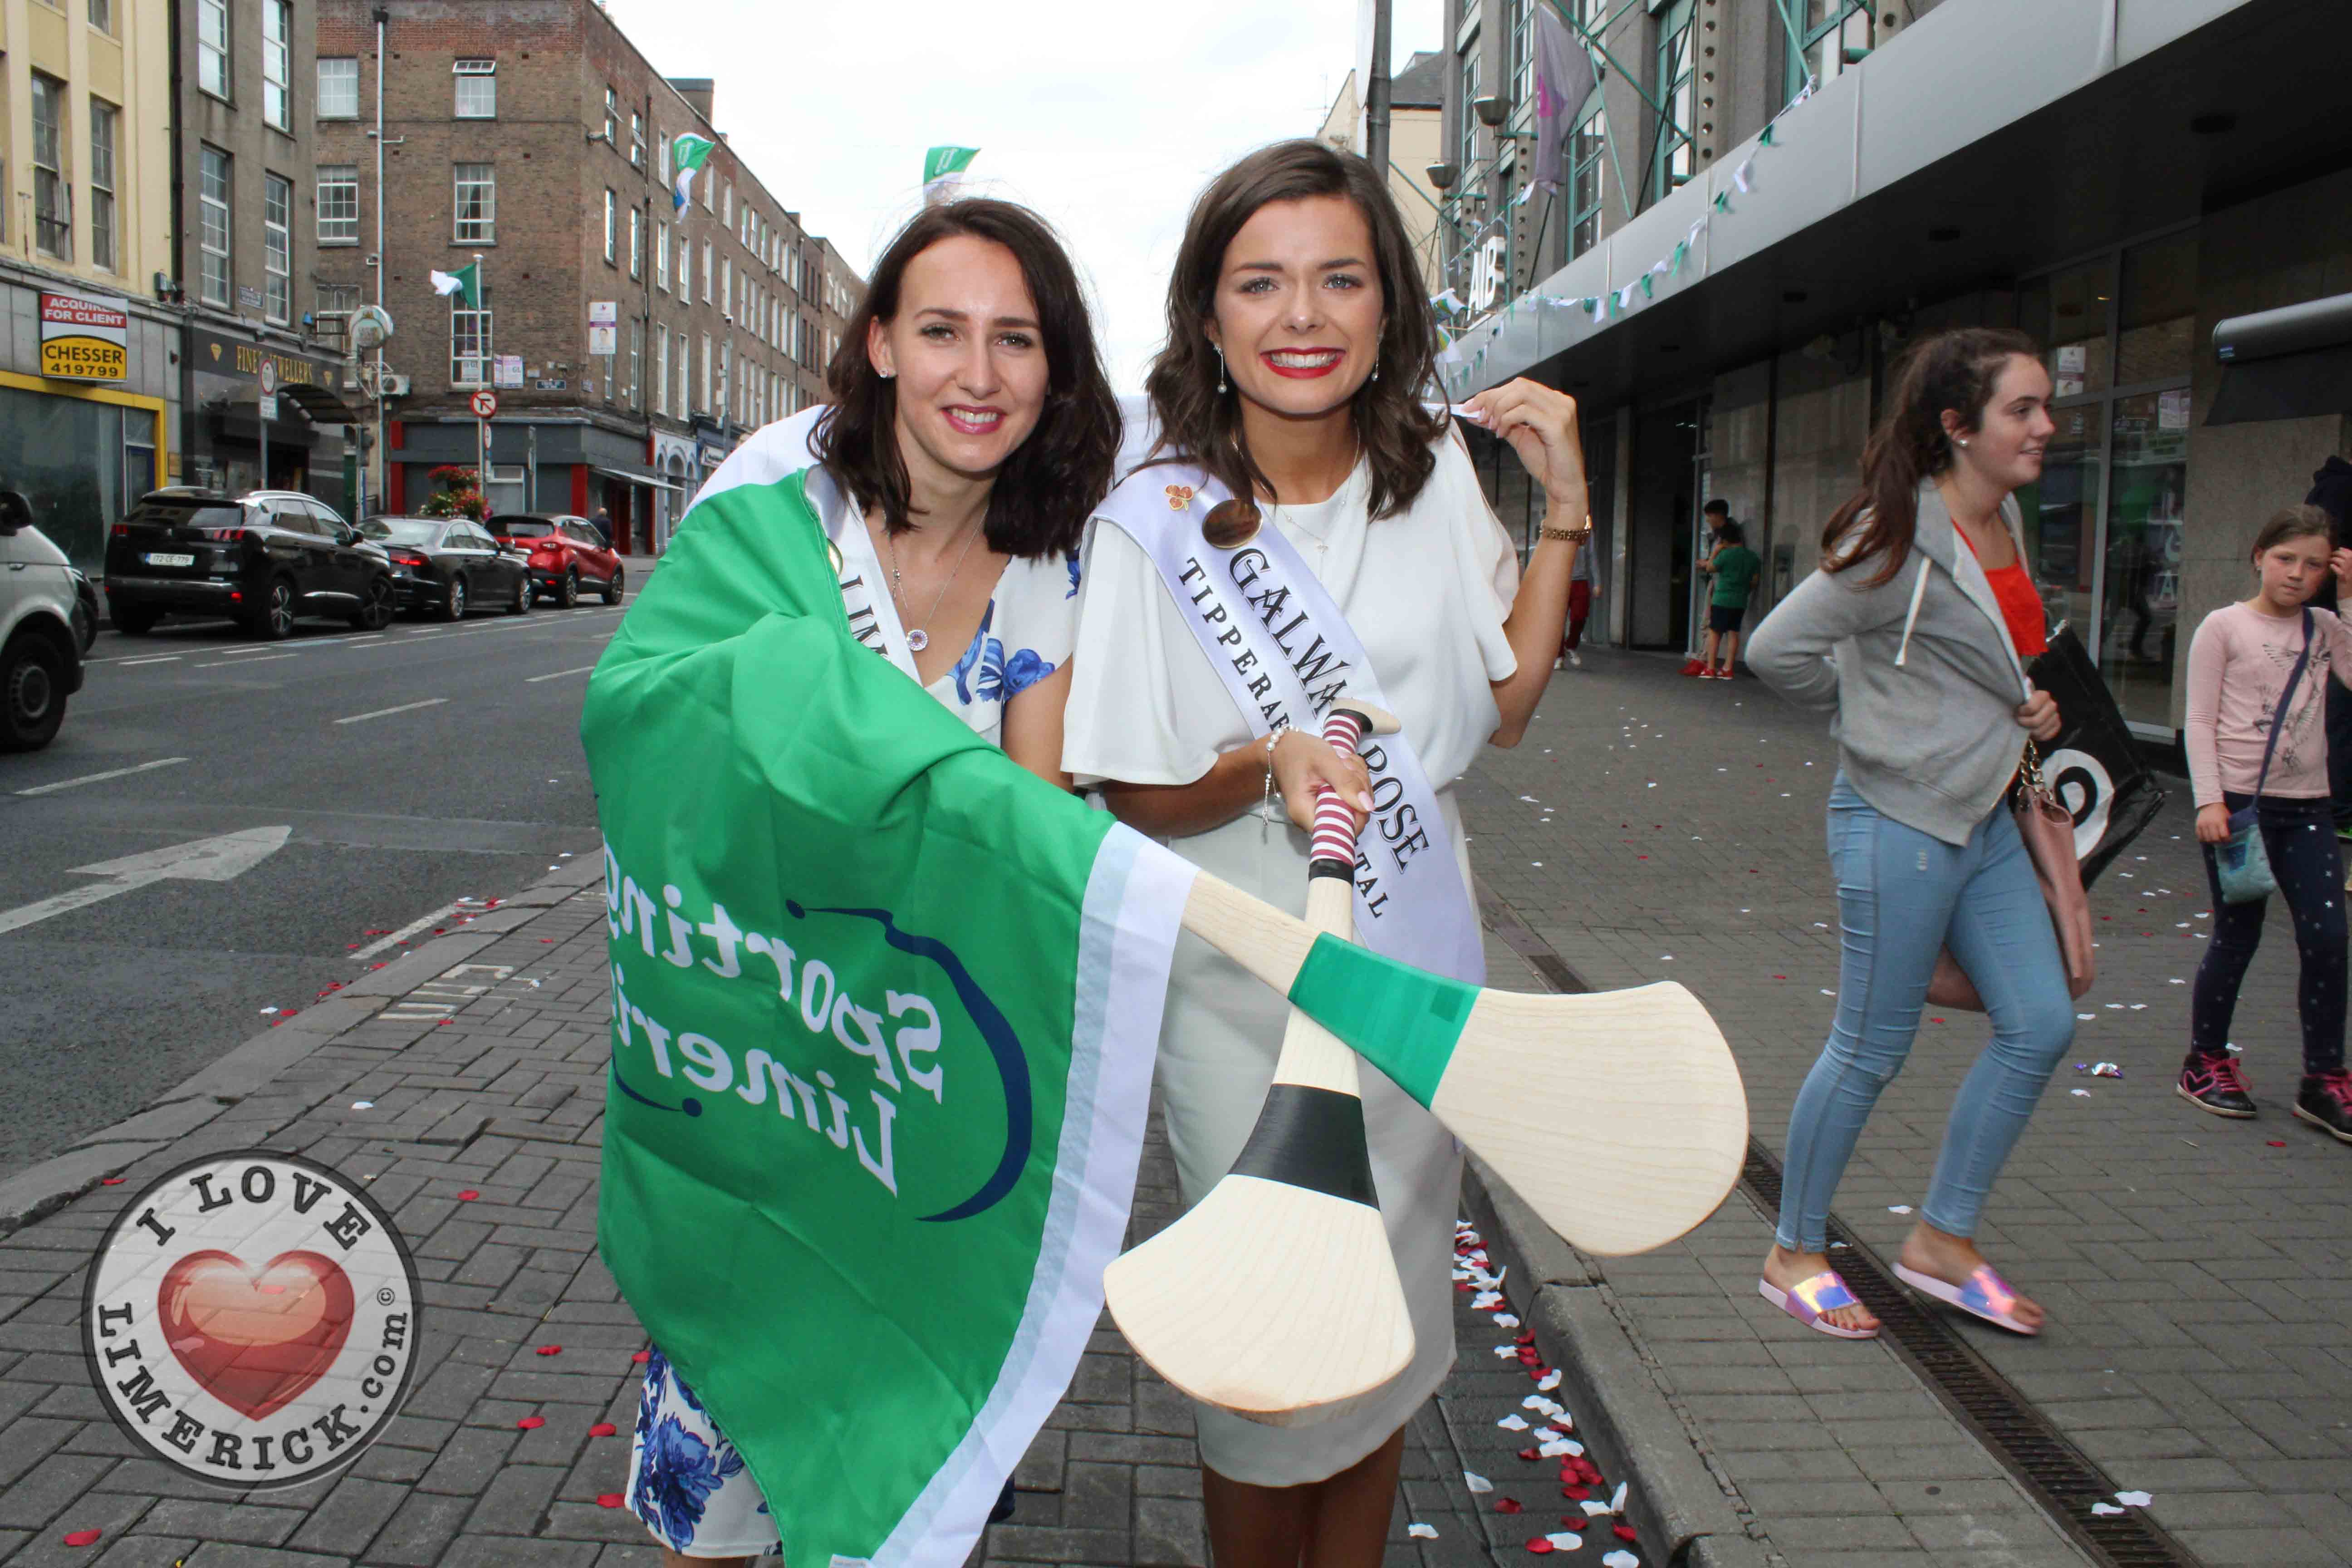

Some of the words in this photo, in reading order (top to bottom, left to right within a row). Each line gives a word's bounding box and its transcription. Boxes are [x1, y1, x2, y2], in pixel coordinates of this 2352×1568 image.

[1466, 236, 1500, 321] AIB
[51, 298, 116, 312] ACQUIR
[44, 309, 73, 320] FOR
[75, 312, 123, 325] CLIENT
[44, 345, 123, 365] CHESSER
[51, 363, 118, 377] 419799
[1229, 548, 1352, 720] GALWA
[1179, 557, 1289, 731] TIPPERAR
[1354, 838, 1389, 919] TAL
